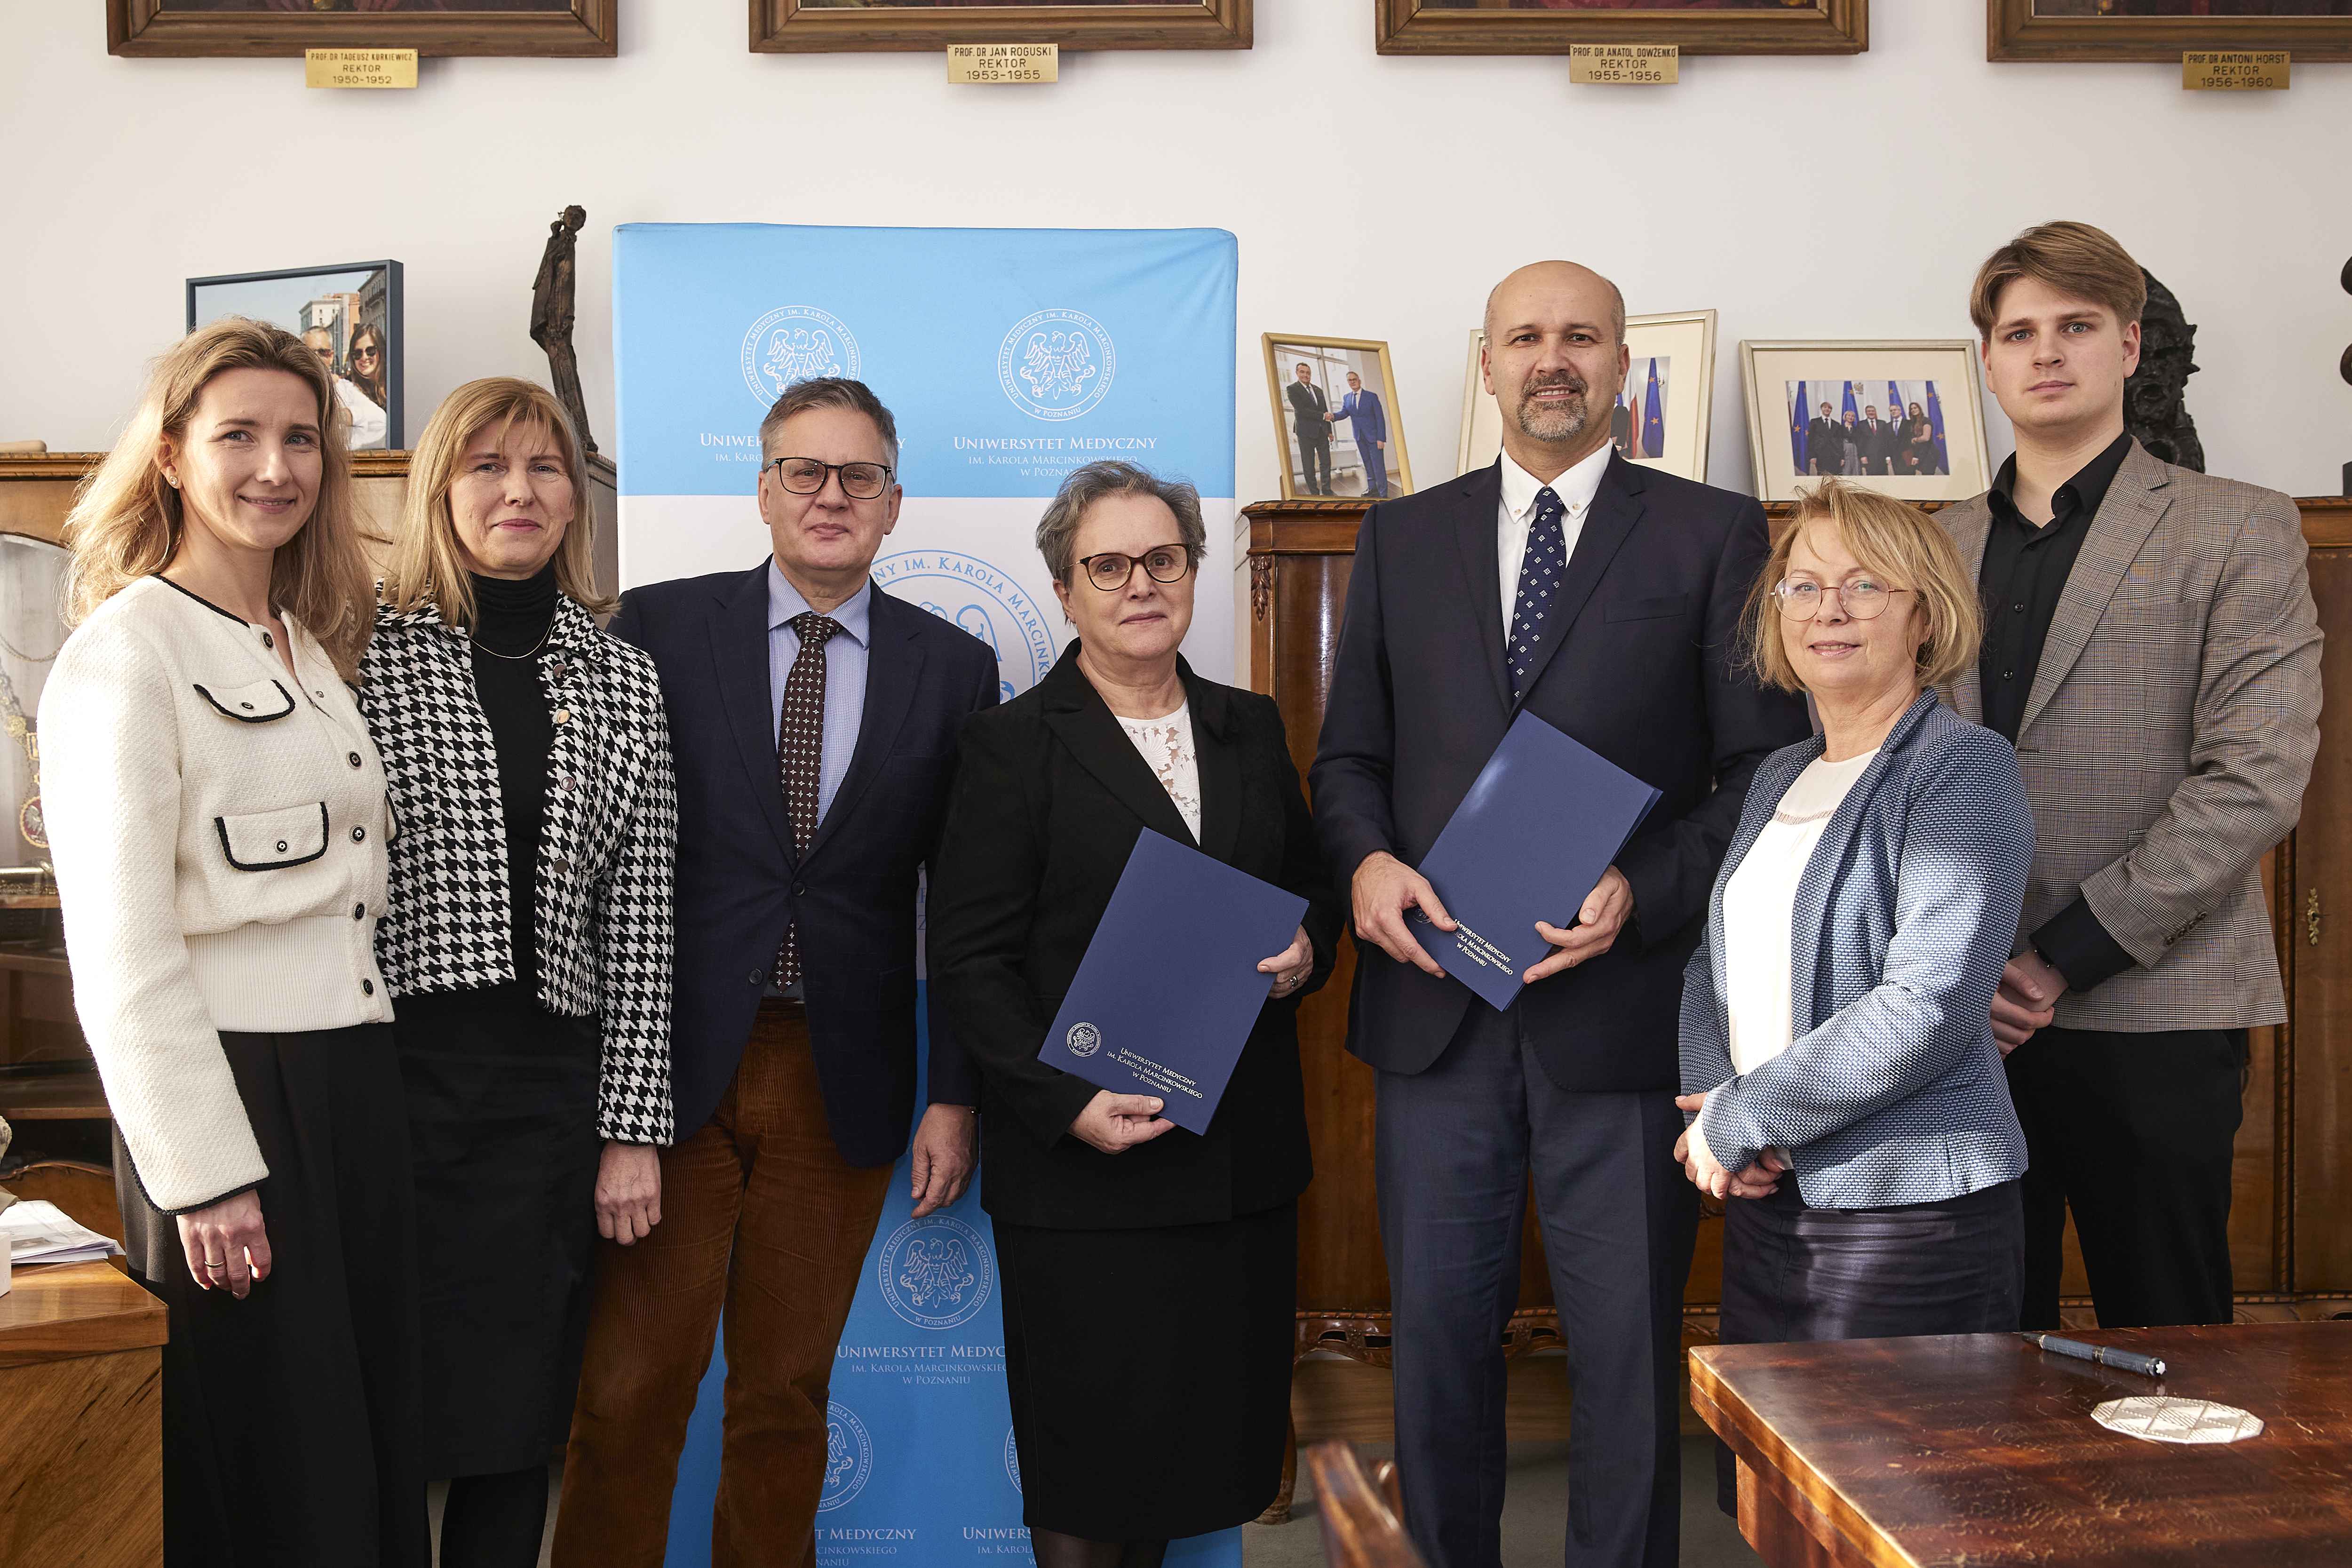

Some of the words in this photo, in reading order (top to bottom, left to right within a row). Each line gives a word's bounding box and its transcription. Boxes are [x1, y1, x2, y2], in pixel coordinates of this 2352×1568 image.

[955, 48, 975, 56] PROF.
[977, 48, 986, 56] DR
[990, 48, 1007, 56] JAN
[1011, 47, 1051, 56] ROGUSKI
[1573, 48, 1592, 56] PROF.
[1595, 48, 1603, 56] DR
[1607, 48, 1633, 57] ANATOL
[979, 59, 1026, 68] REKTOR
[1601, 59, 1647, 68] REKTOR
[2188, 55, 2207, 64] PROF.
[2209, 55, 2218, 64] DR
[2221, 55, 2253, 64] ANTONI
[2257, 55, 2285, 64] HORST
[966, 70, 1041, 80] 1953-1955
[1589, 71, 1661, 80] 1955-1956
[2213, 66, 2259, 75] REKTOR
[2201, 77, 2273, 87] 1956-1960
[750, 310, 785, 340] MEDYCZNY
[804, 309, 835, 326] KAROLA
[1062, 312, 1092, 327] KAROLA
[1008, 314, 1043, 344] MEDYCZNY
[745, 342, 763, 396] UNIWERSYTET
[1093, 326, 1112, 398] MARCINKOWSKIEGO
[1002, 347, 1019, 399] UNIWERSYTET
[1043, 407, 1081, 417] POZNANIU
[954, 437, 1065, 449] UNIWERSYTET
[1070, 437, 1157, 449] MEDYCZNY
[715, 453, 731, 462] IM.
[969, 456, 984, 464] IM.
[988, 455, 1029, 464] KAROLA
[904, 558, 930, 571] IM.
[939, 556, 1004, 594] KAROLA
[1461, 945, 1487, 967] POZNANIU
[1467, 940, 1513, 975] MARCINKOWSKIEGO
[1484, 942, 1511, 963] MEDYCZNY
[1120, 1047, 1162, 1071] UNIWERSYTET
[1162, 1067, 1197, 1087] MEDYCZNY
[1117, 1055, 1142, 1071] KAROLA
[1143, 1067, 1203, 1099] MARCINKOWSKIEGO
[1139, 1074, 1172, 1093] POZNANIU
[938, 1219, 968, 1234] KAROLA
[888, 1221, 921, 1252] MEDYCZNY
[970, 1234, 990, 1306] MARCINKOWSKIEGO
[882, 1255, 899, 1308] UNIWERSYTET
[924, 1316, 961, 1326] POZNANIU
[837, 1345, 946, 1359] UNIWERSYTET
[871, 1363, 911, 1372] KAROLA
[916, 1375, 970, 1385] POZNANIU
[828, 1405, 847, 1418] ROLA
[849, 1418, 869, 1490] MARCINKOWSKIEGO
[830, 1528, 917, 1540] MEDYCZNY
